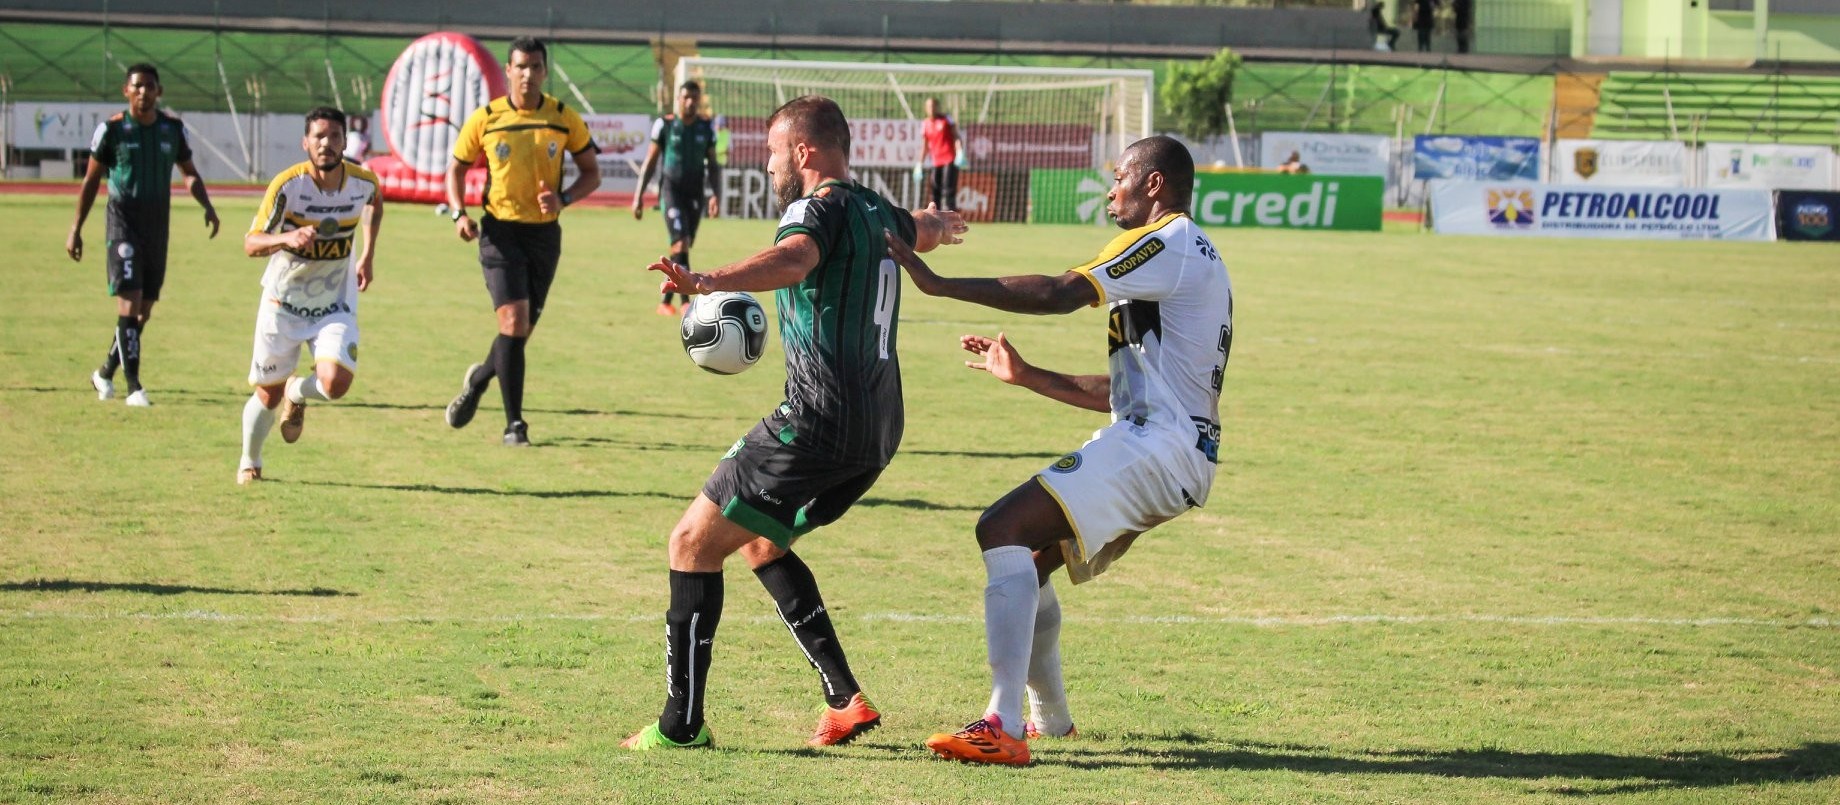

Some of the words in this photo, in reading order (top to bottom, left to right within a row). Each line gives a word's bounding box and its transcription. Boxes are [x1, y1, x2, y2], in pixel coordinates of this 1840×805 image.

[1541, 191, 1721, 220] PETROALCOOL
[1625, 223, 1637, 231] DE
[123, 259, 133, 279] 5
[1110, 241, 1163, 276] COOPAVEL
[873, 259, 897, 360] 9
